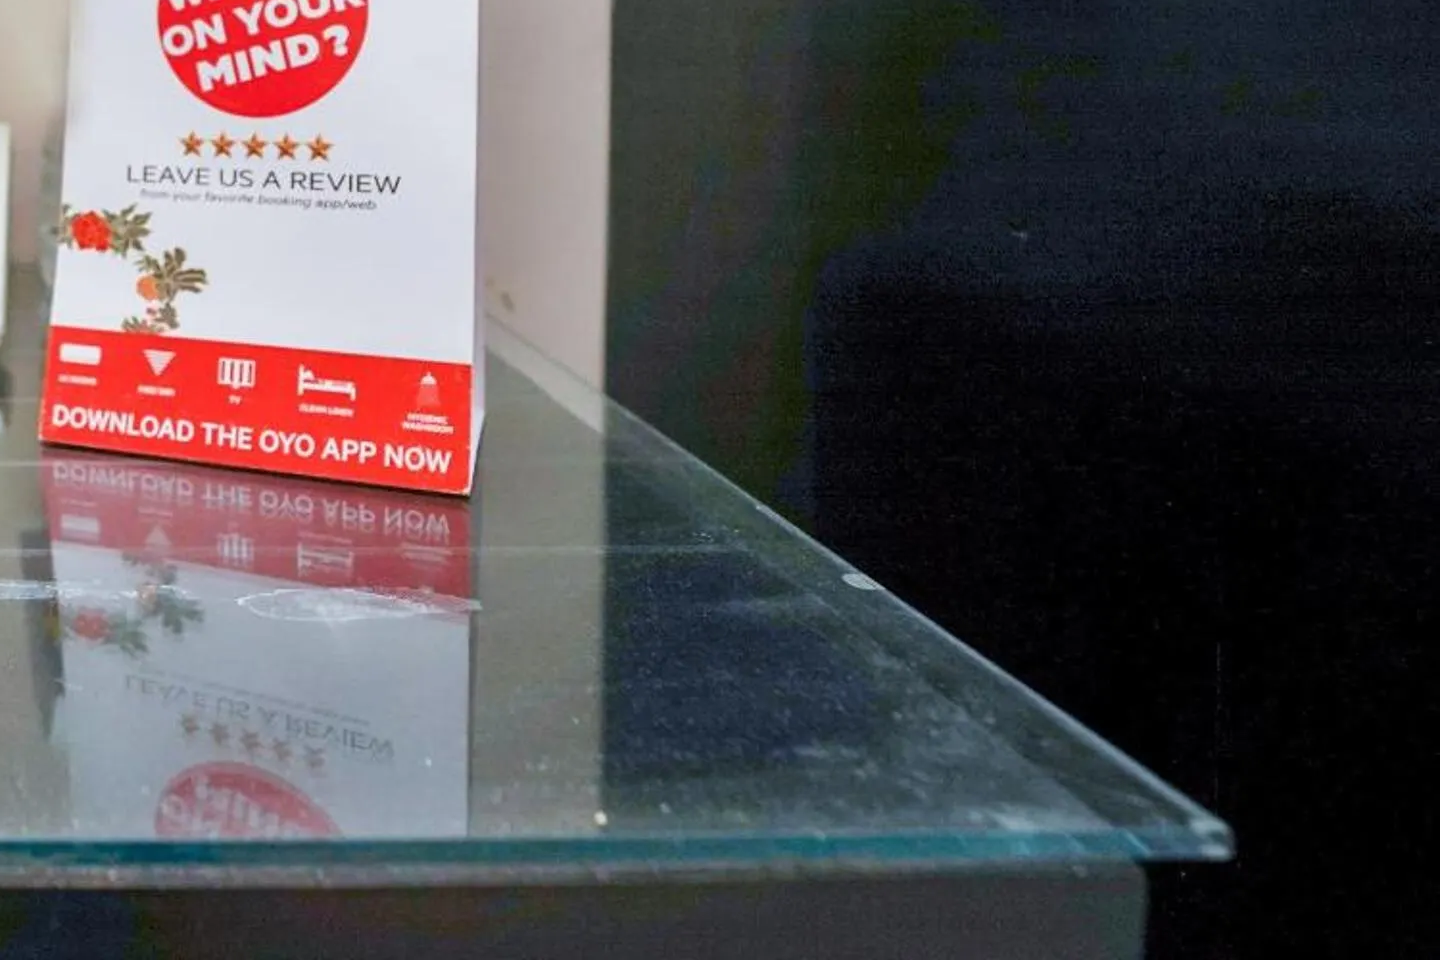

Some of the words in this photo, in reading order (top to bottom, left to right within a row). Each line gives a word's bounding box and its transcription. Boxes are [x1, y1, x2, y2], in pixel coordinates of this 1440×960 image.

[162, 13, 228, 57] ON
[126, 164, 211, 186] LEAVE
[219, 168, 254, 188] US
[262, 171, 282, 190] A
[290, 171, 402, 195] REVIEW
[257, 194, 312, 209] booking
[314, 199, 378, 212] app/web
[51, 403, 196, 443] DOWNLOAD
[200, 421, 255, 451] THE
[258, 429, 316, 458] OYO
[321, 436, 378, 465] APP
[383, 443, 453, 475] NOW
